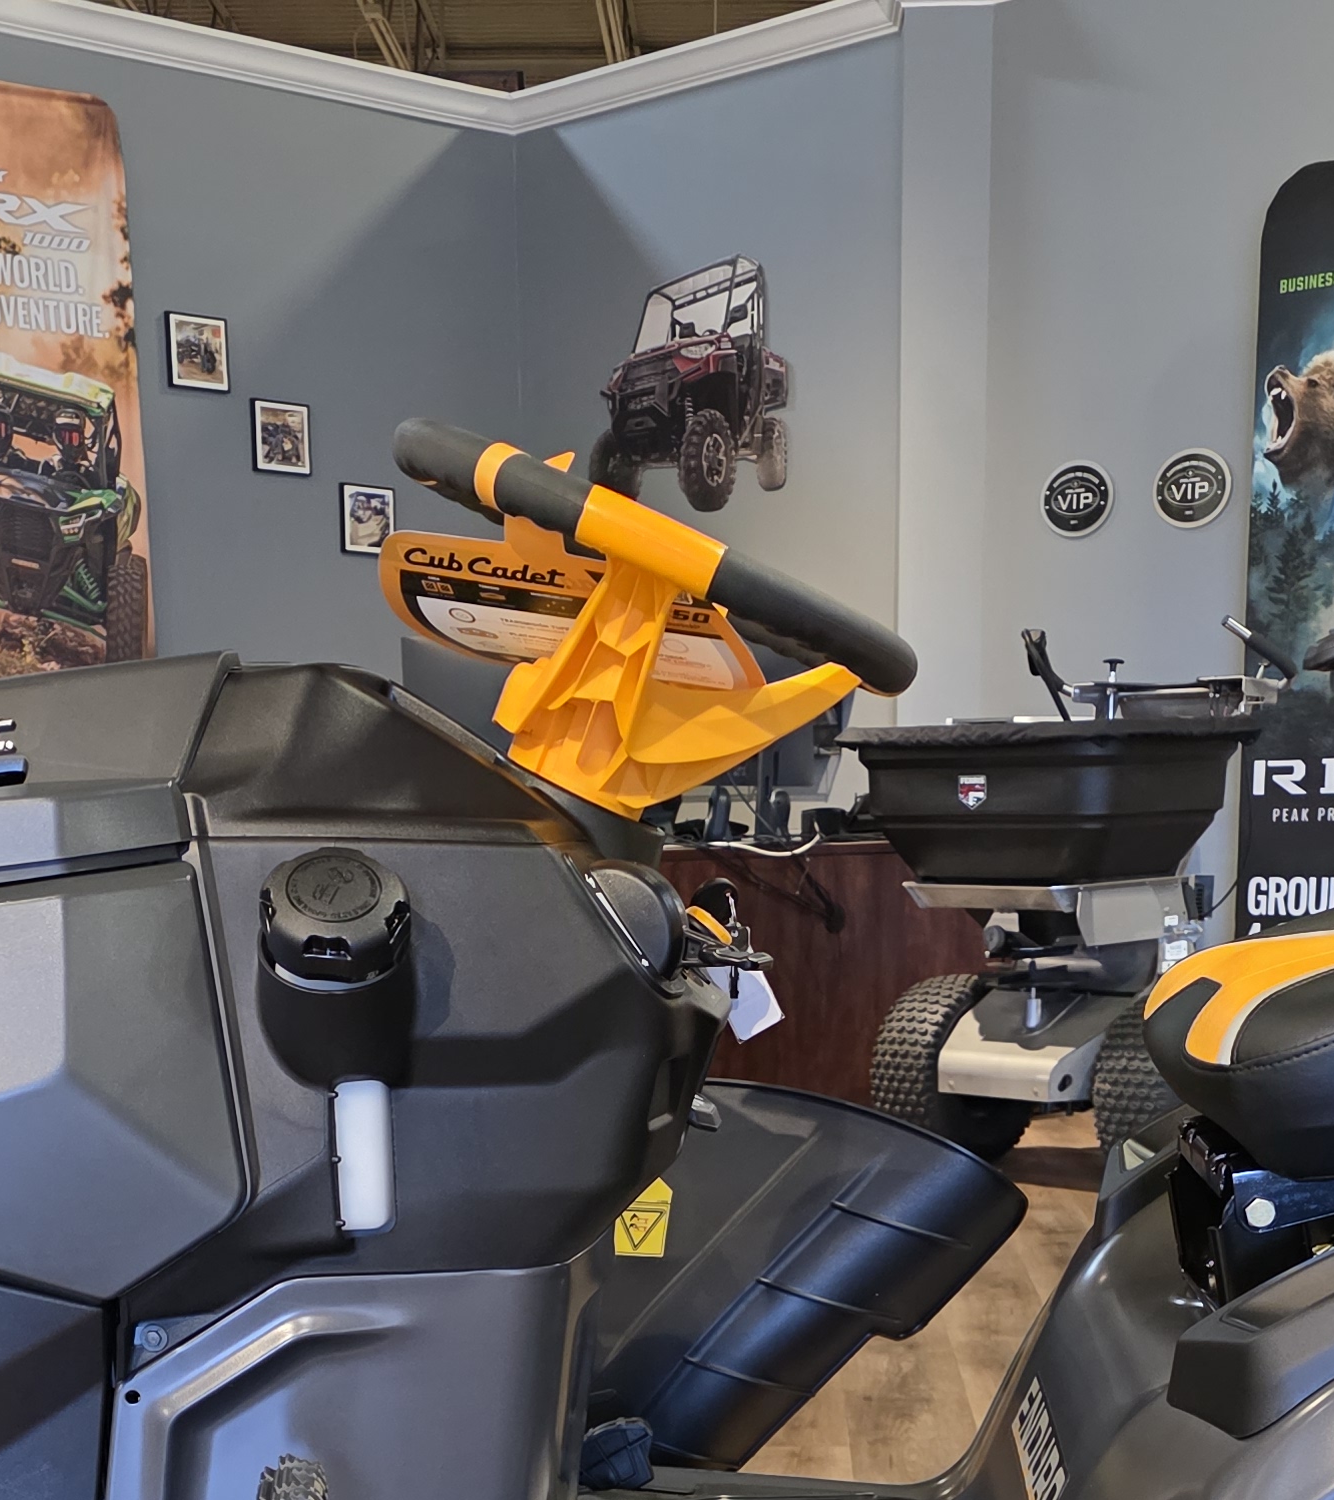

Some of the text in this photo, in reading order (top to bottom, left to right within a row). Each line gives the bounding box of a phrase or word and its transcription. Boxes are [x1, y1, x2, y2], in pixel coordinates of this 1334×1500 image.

[22, 230, 91, 252] 1000
[1170, 481, 1209, 500] VIP
[1057, 492, 1093, 511] VIP
[404, 547, 566, 589] Cub Cadet
[1272, 807, 1309, 823] PEAK
